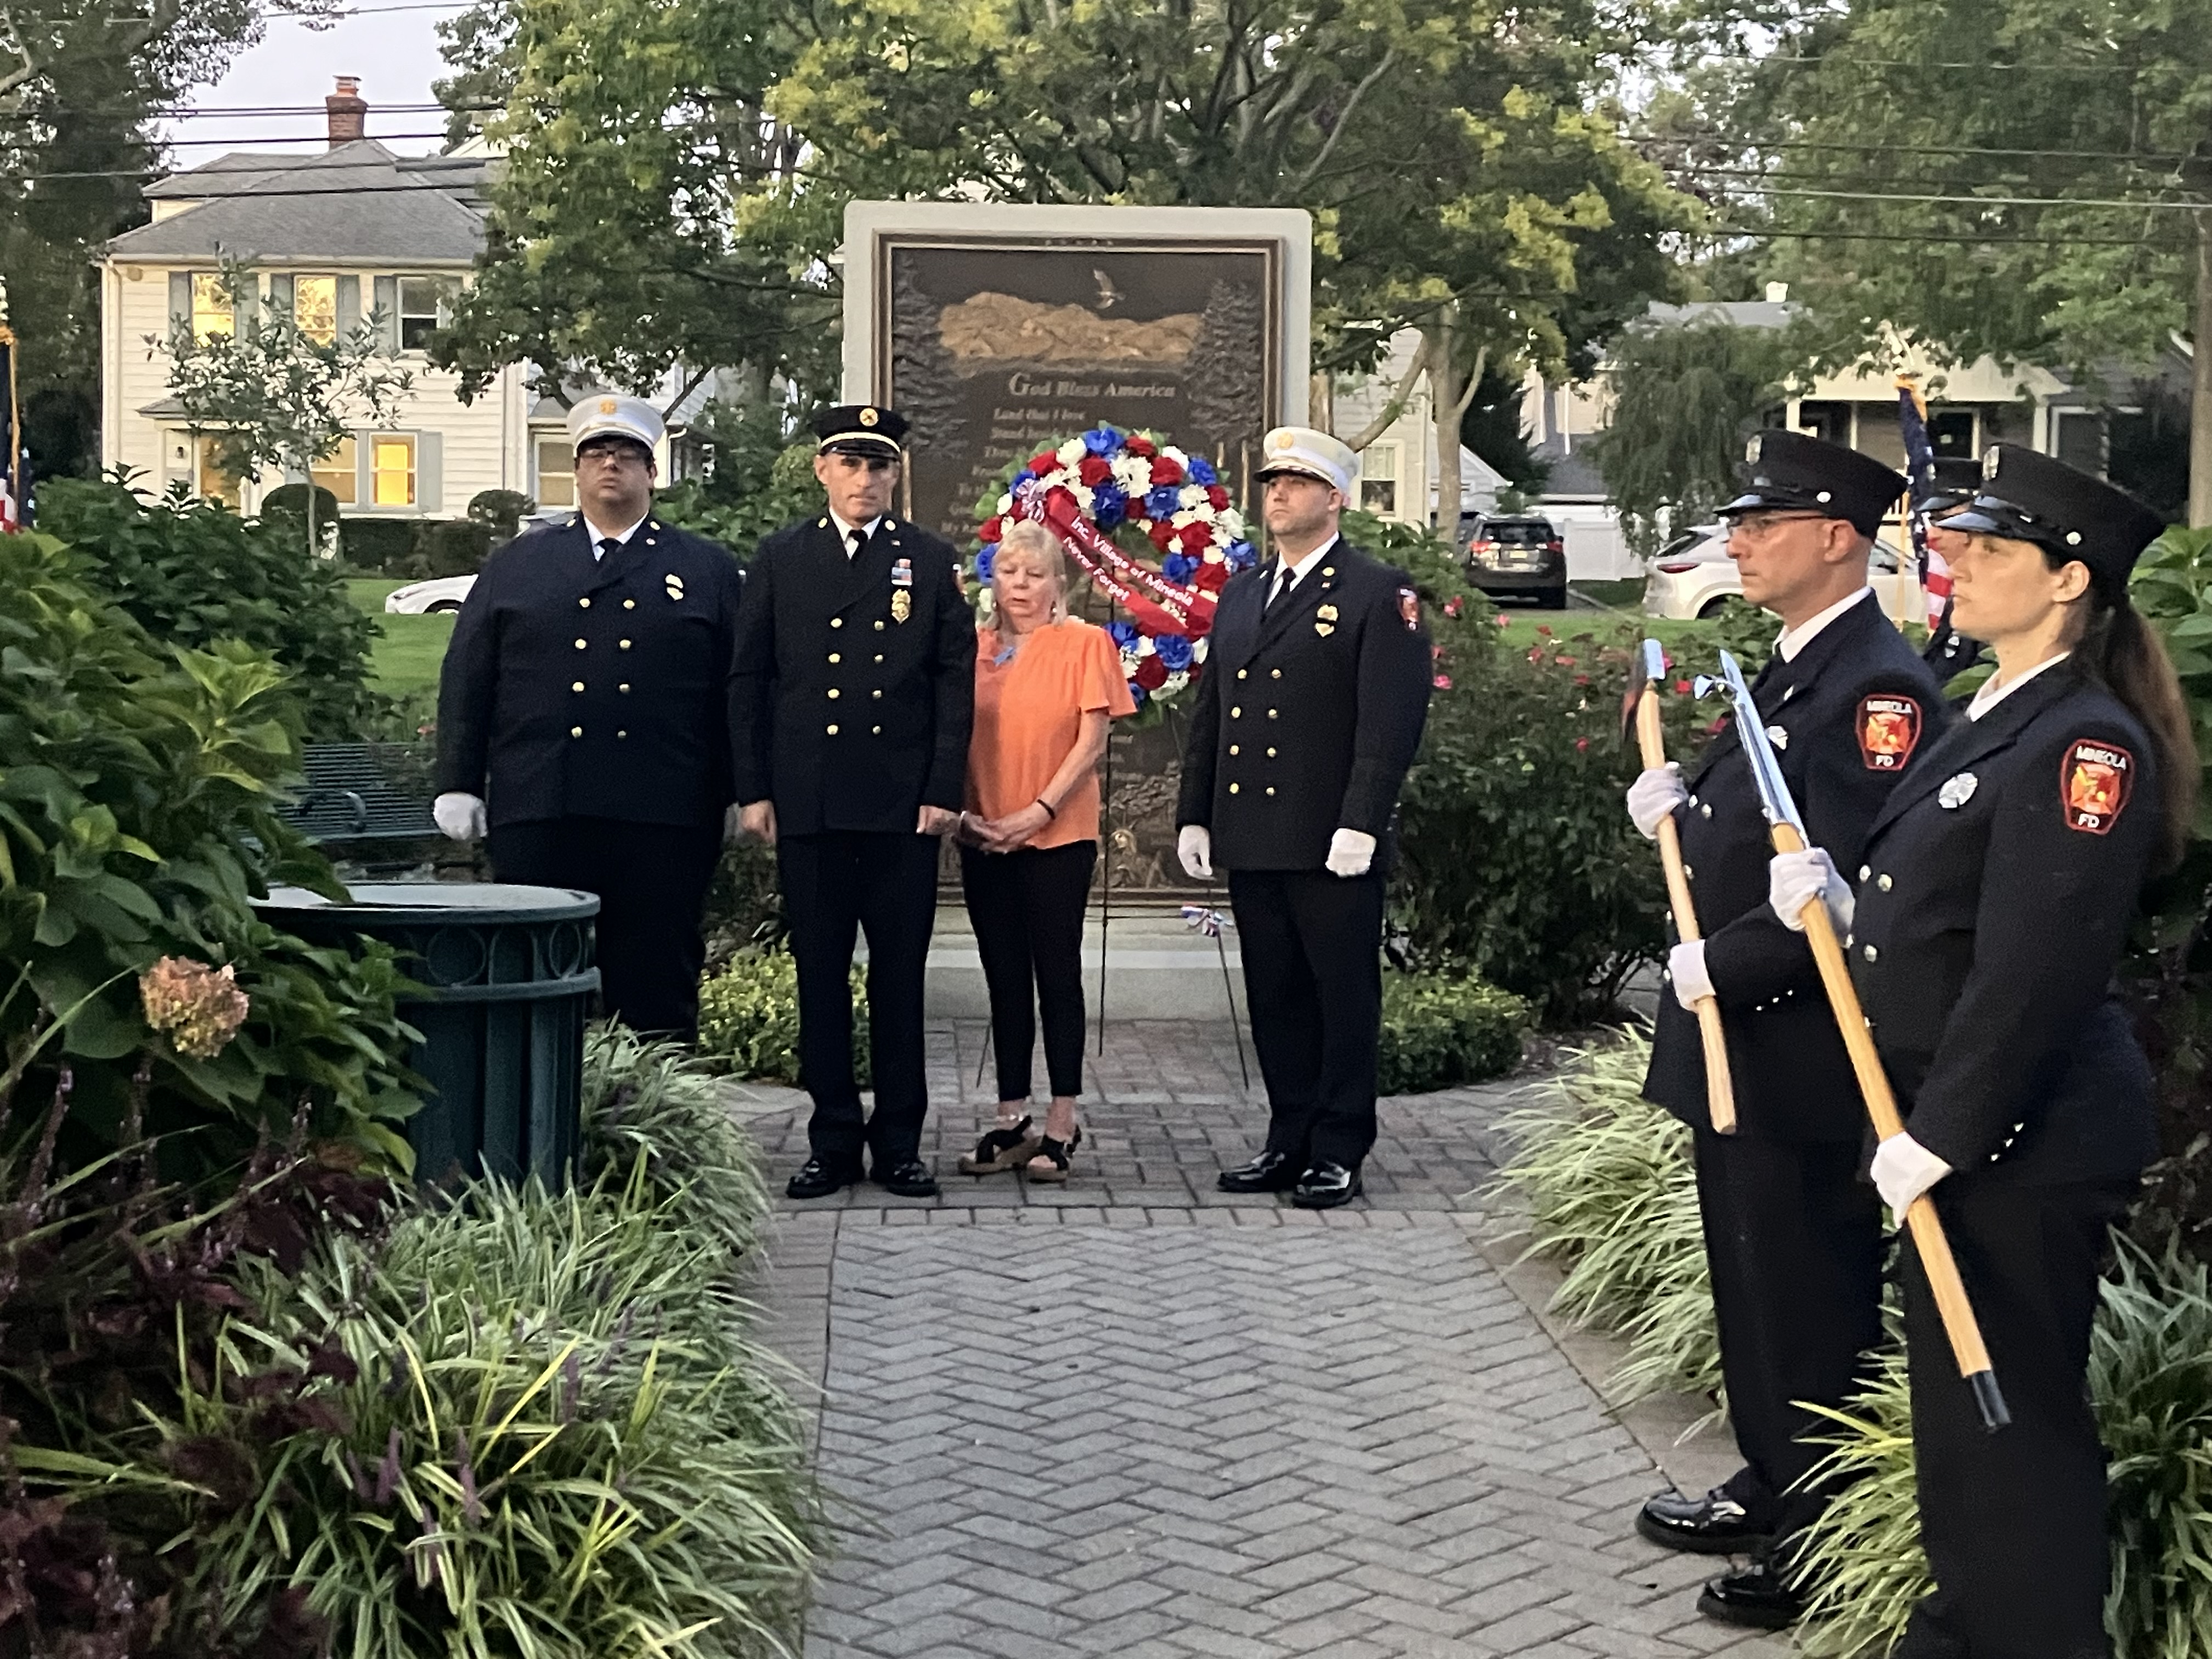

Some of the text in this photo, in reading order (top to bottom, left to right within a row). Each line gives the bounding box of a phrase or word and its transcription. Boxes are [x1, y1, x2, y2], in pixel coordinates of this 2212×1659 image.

[1009, 372, 1052, 396] God
[1104, 382, 1176, 397] America
[1063, 537, 1130, 601] Never Forget
[1093, 534, 1129, 569] Village
[1130, 567, 1146, 578] of
[1146, 574, 1193, 606] Mineola
[1876, 755, 1894, 767] FD
[2078, 813, 2100, 828] FD
